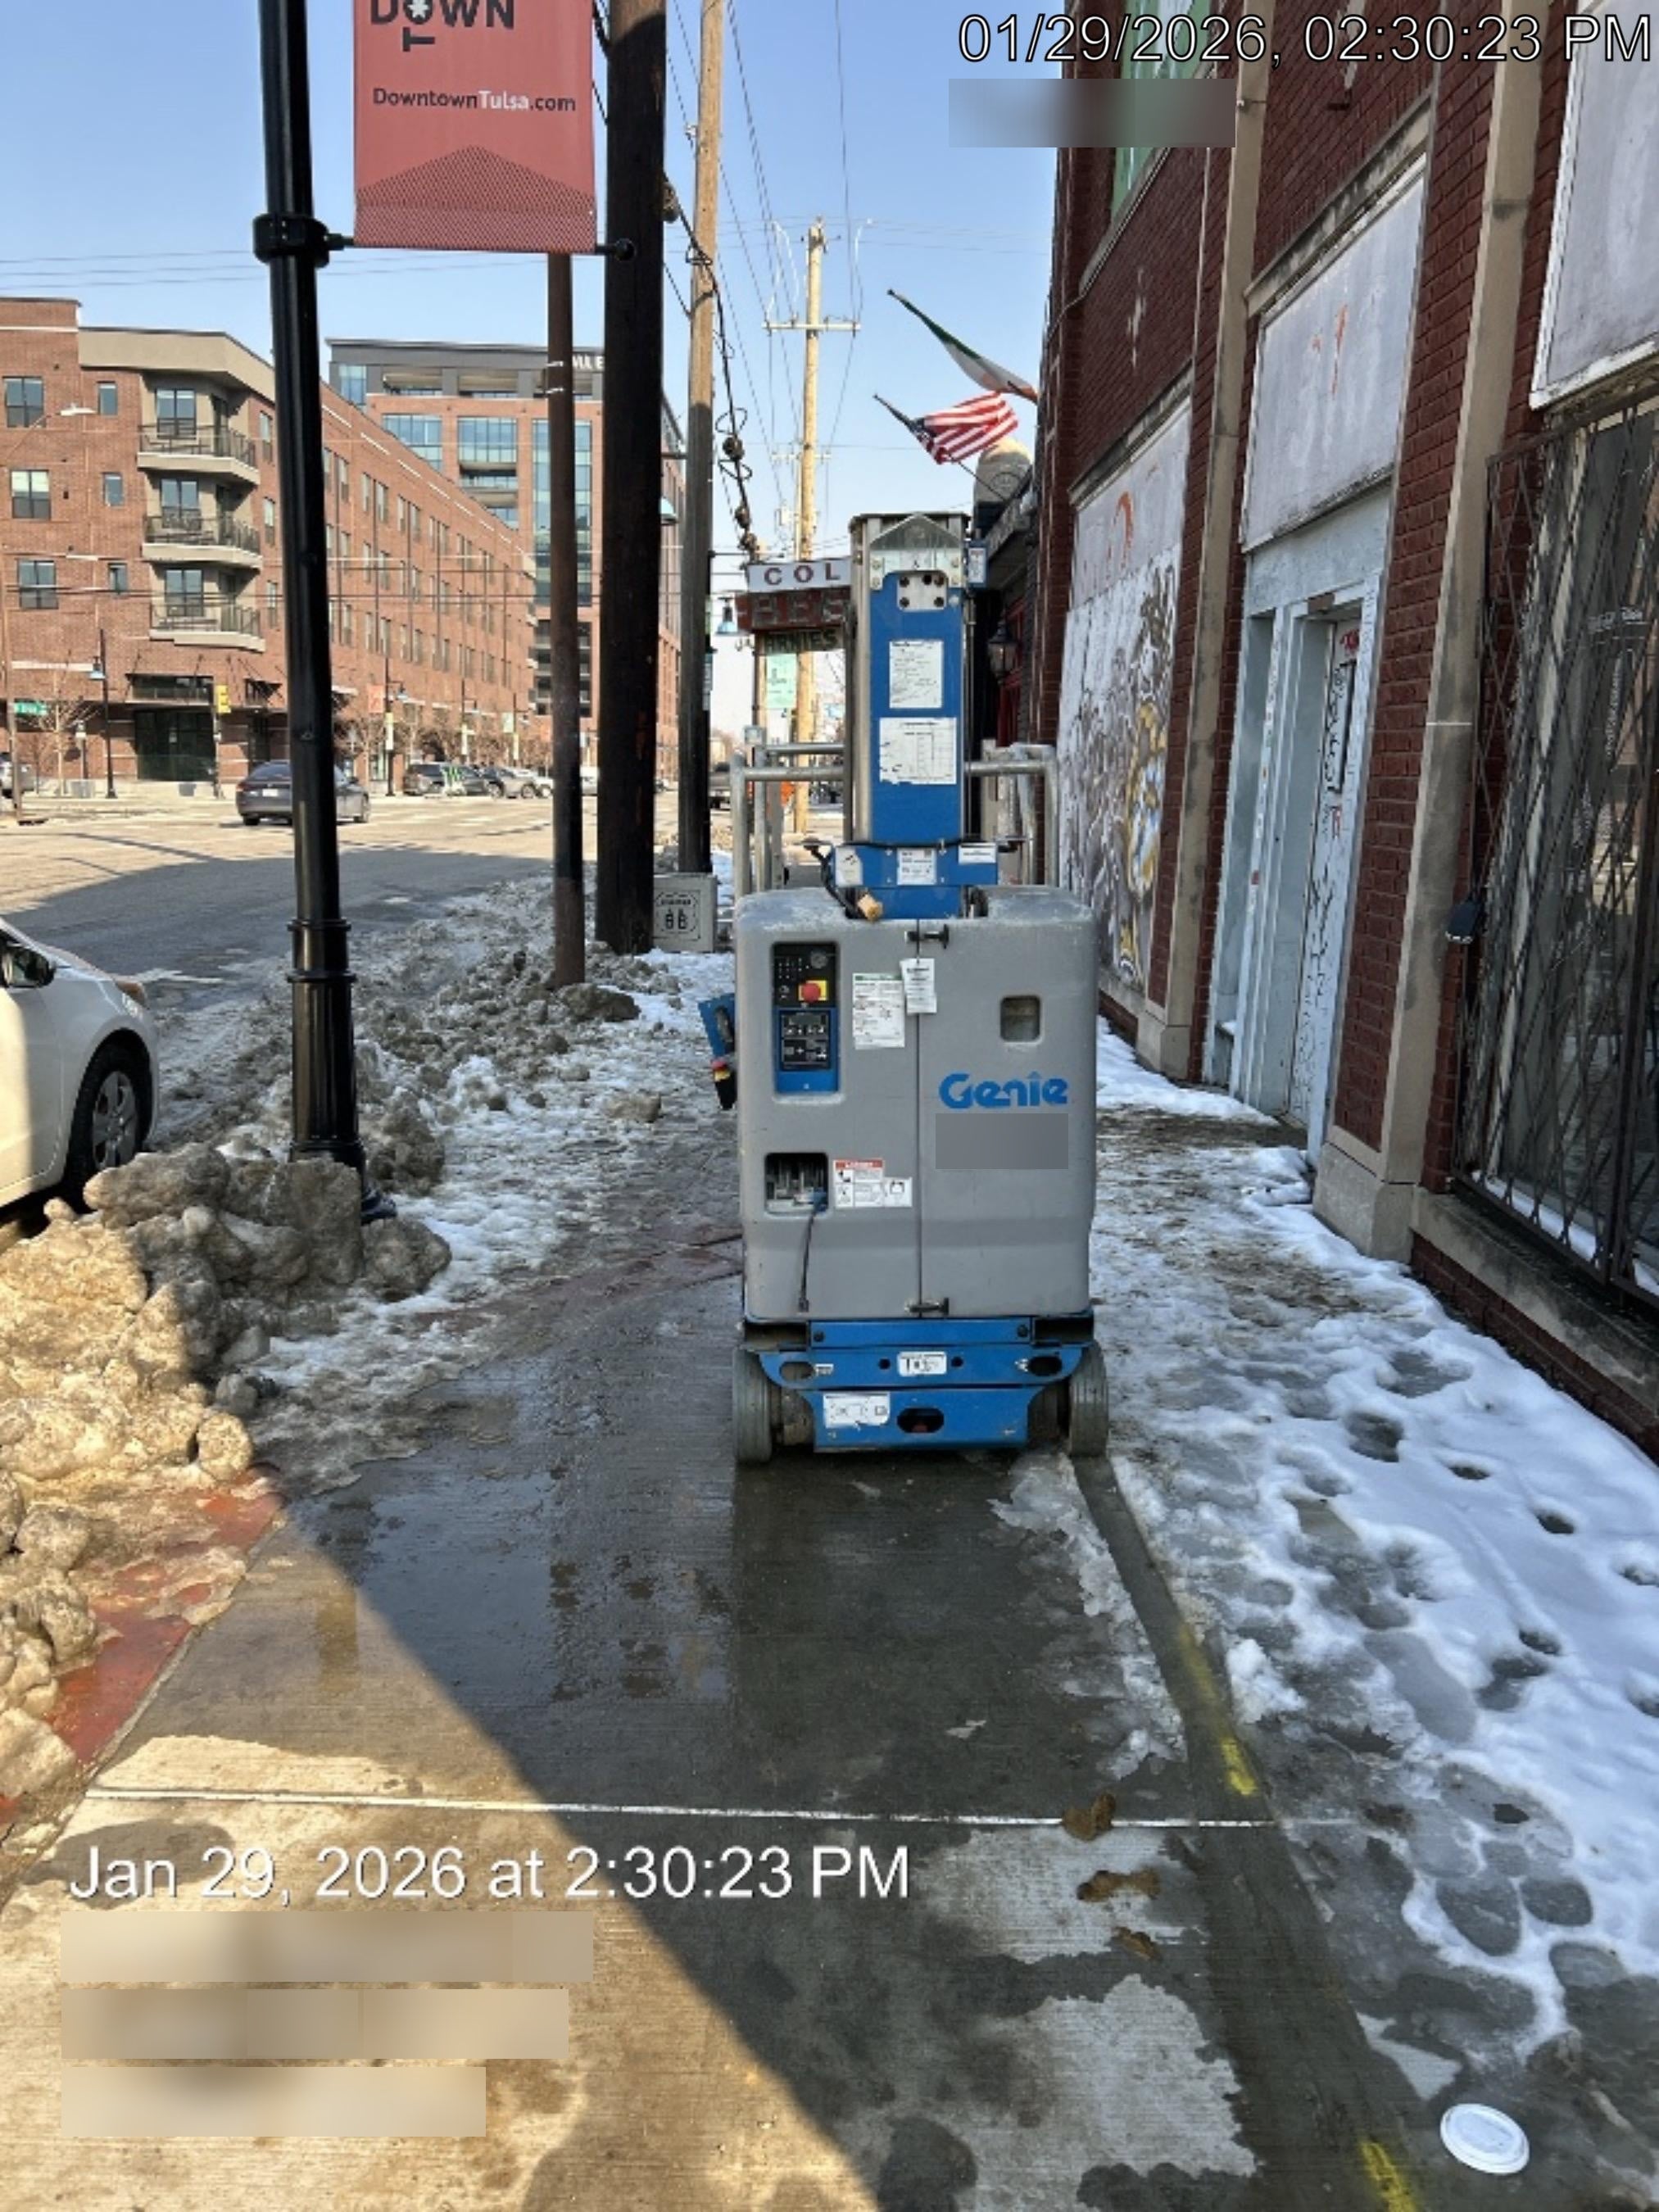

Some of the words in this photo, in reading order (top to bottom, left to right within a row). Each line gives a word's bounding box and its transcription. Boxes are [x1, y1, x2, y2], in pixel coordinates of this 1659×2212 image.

[372, 87, 577, 112] DowntownTulsa.com
[764, 562, 842, 586] COL
[939, 1071, 1069, 1109] Genie
